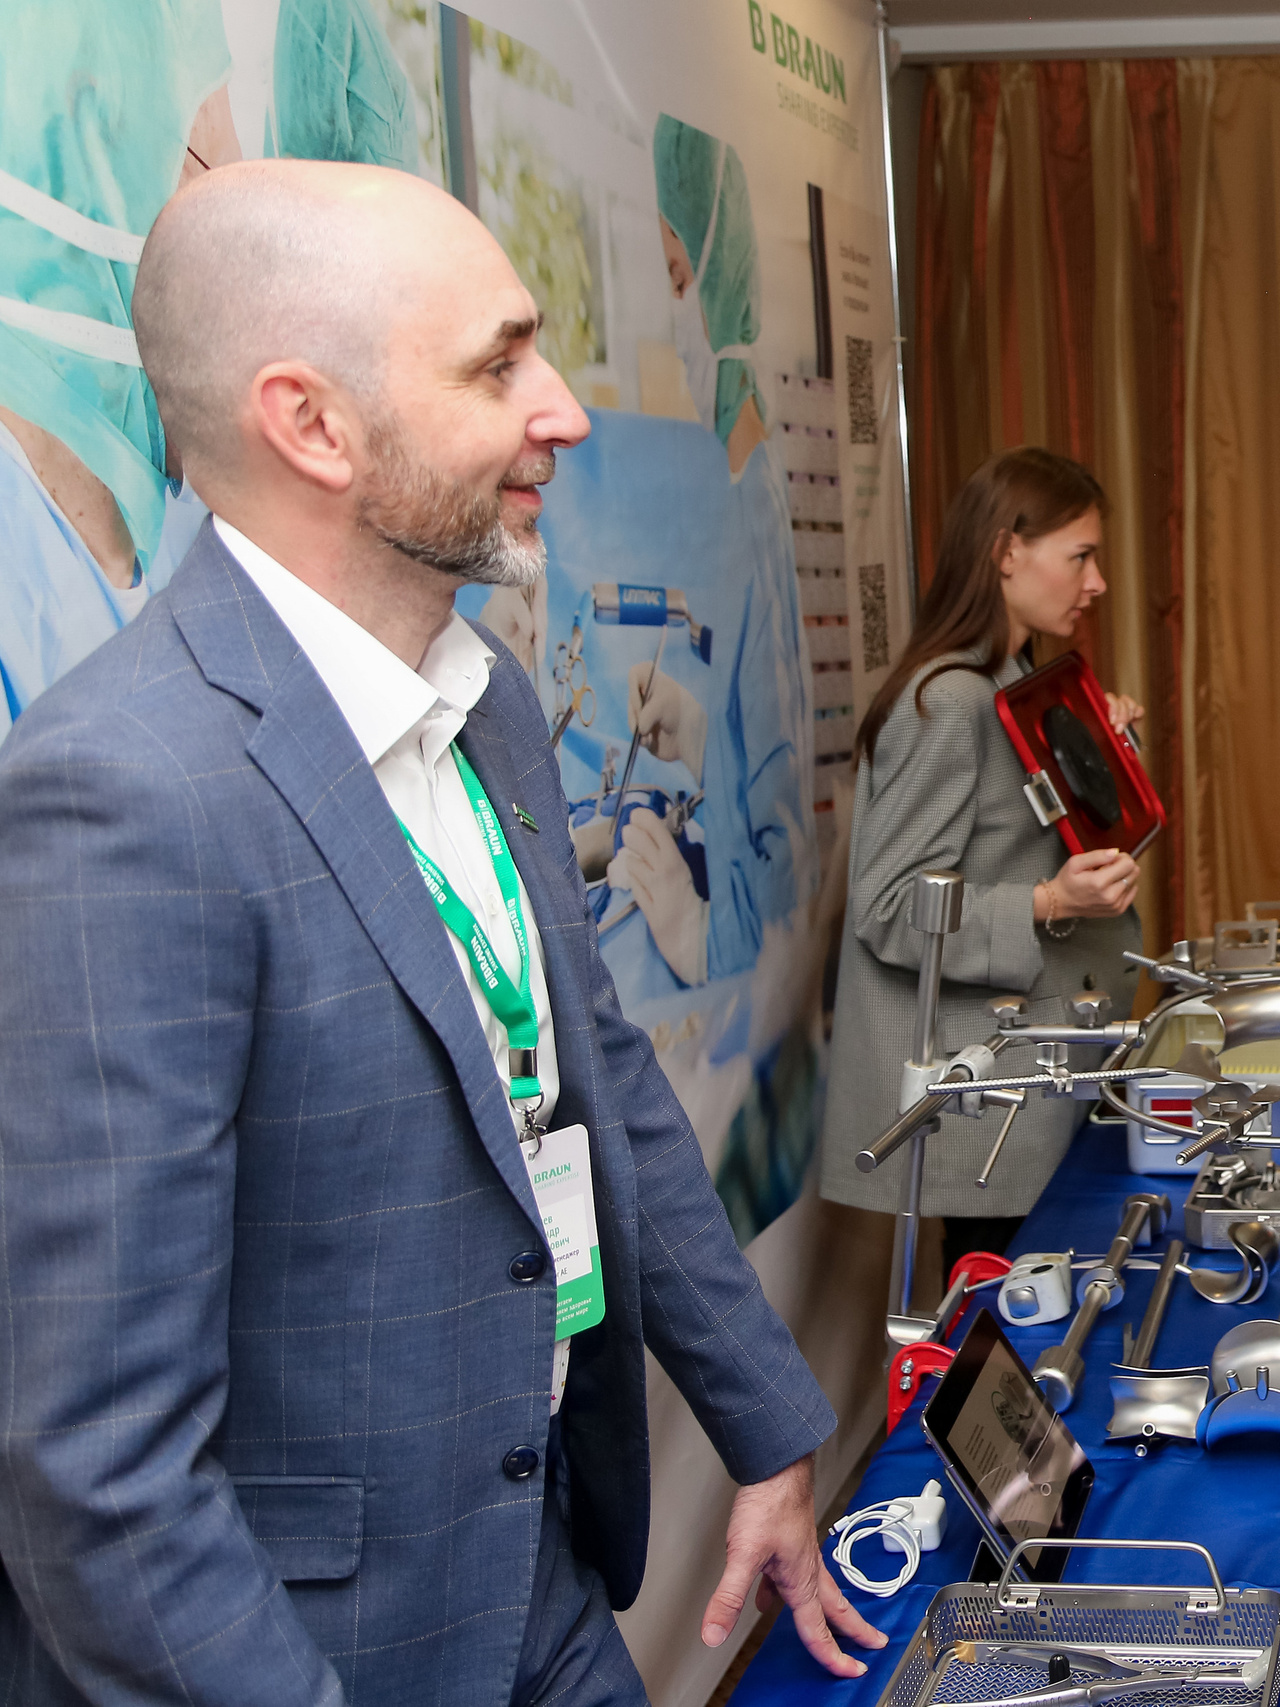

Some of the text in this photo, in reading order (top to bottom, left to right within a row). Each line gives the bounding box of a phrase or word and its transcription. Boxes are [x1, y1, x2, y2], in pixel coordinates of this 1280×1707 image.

[770, 12, 847, 104] BRAUN
[534, 1162, 571, 1184] BRAUN
[550, 1237, 570, 1250] ович
